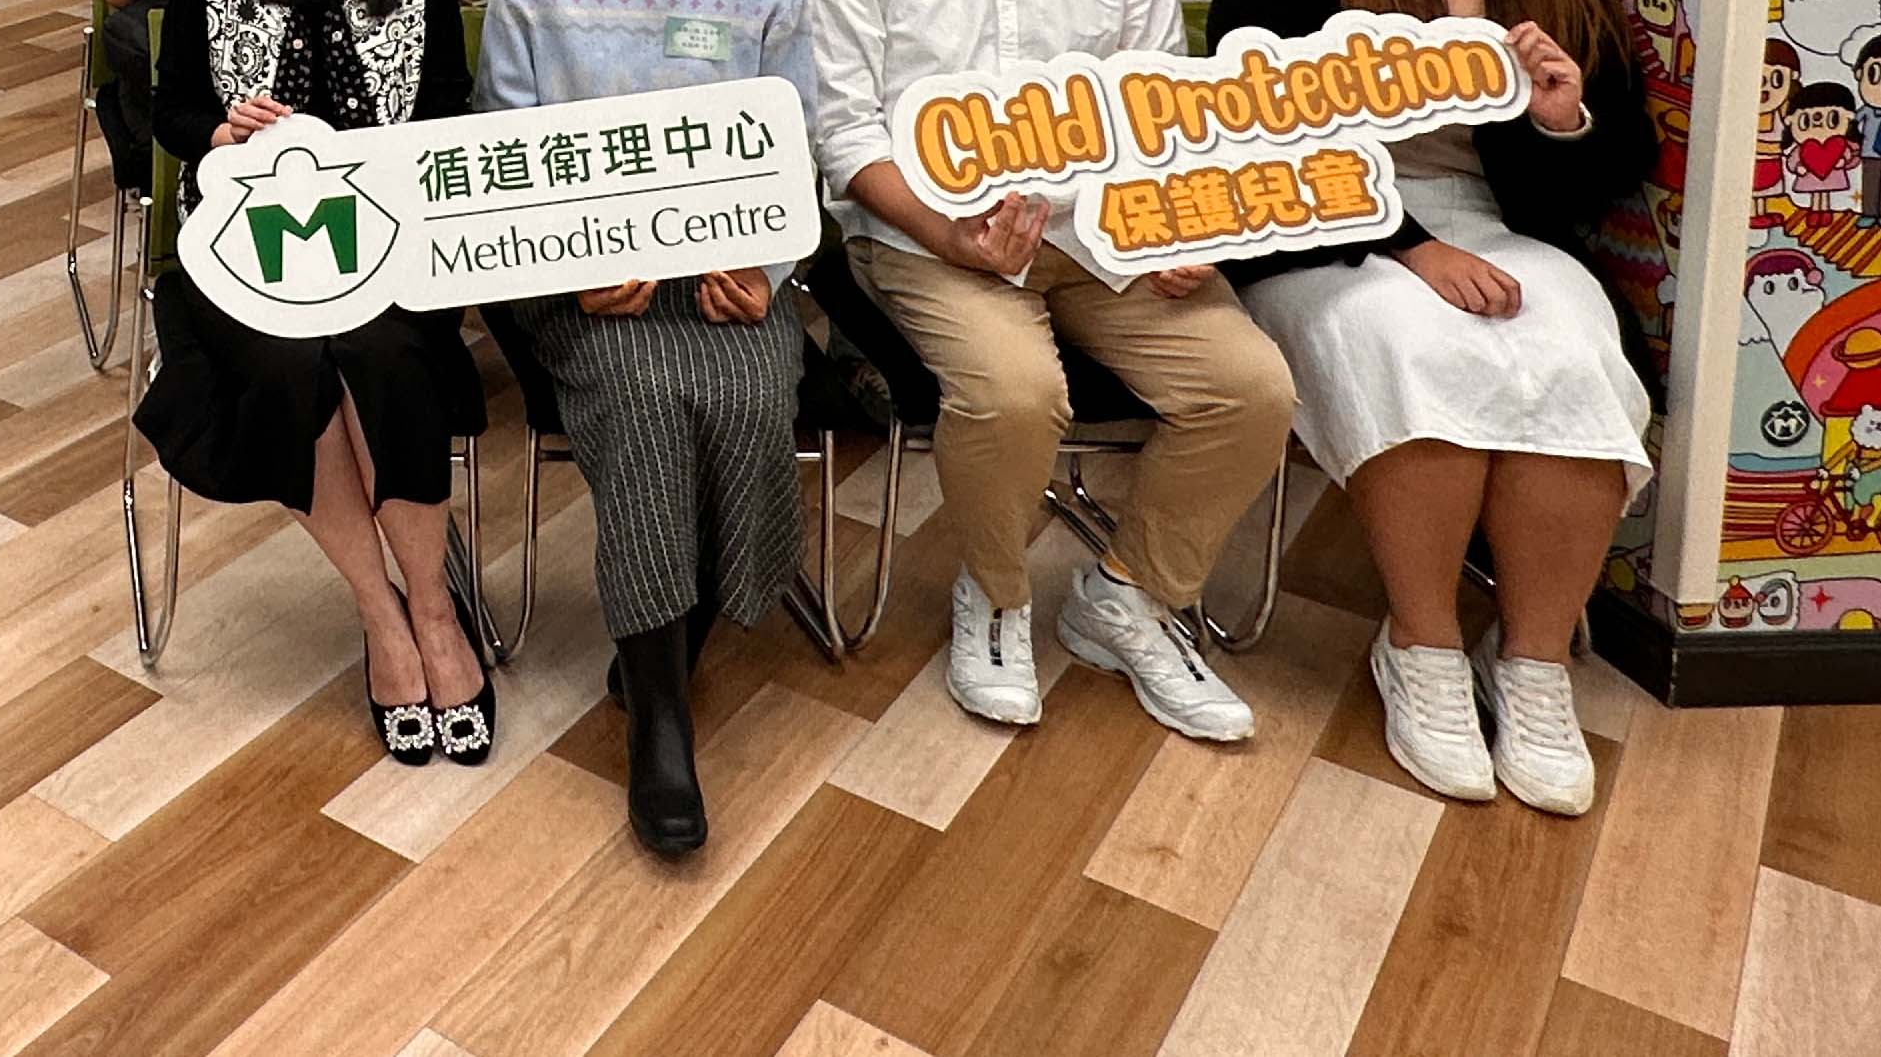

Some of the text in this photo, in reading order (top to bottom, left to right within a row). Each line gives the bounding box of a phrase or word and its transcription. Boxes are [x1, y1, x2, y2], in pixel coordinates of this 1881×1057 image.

[914, 74, 1107, 195] Child
[430, 200, 788, 278] Methodist Centre
[1098, 148, 1380, 253] 保護兒童
